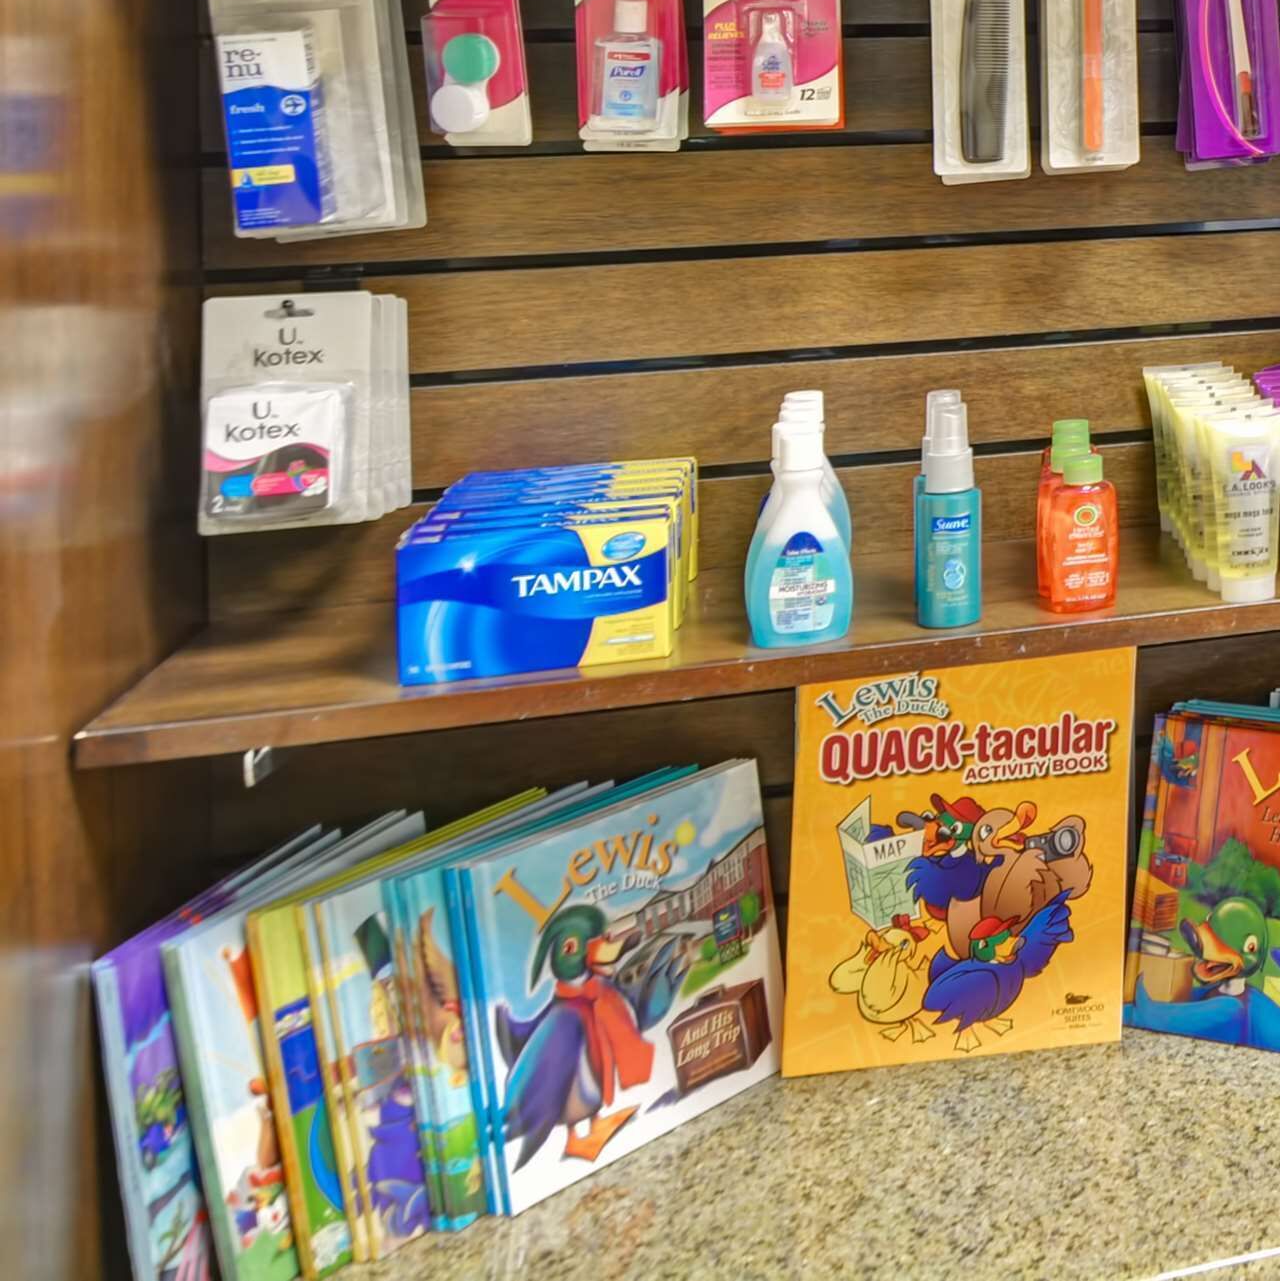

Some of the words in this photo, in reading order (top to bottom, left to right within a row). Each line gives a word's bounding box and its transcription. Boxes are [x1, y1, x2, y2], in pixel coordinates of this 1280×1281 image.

[225, 62, 263, 79] nu
[800, 88, 816, 101] 12
[253, 348, 324, 368] kotex
[223, 422, 301, 444] kotex
[933, 517, 970, 532] Suave
[511, 564, 643, 598] TAMPAX
[818, 670, 939, 726] Lewis
[860, 707, 892, 723] The
[896, 697, 949, 718] Duck's
[821, 713, 1113, 784] QUACK-tacular
[965, 760, 1047, 782] ACTIVITY
[1052, 755, 1107, 772] BOOK
[872, 839, 907, 860] MAP
[491, 814, 680, 933] Lewis
[585, 882, 618, 905] The
[622, 871, 663, 891] Duck
[681, 1024, 709, 1048] And
[712, 1010, 733, 1034] His
[676, 1041, 711, 1069] Long
[713, 1027, 741, 1052] Trip
